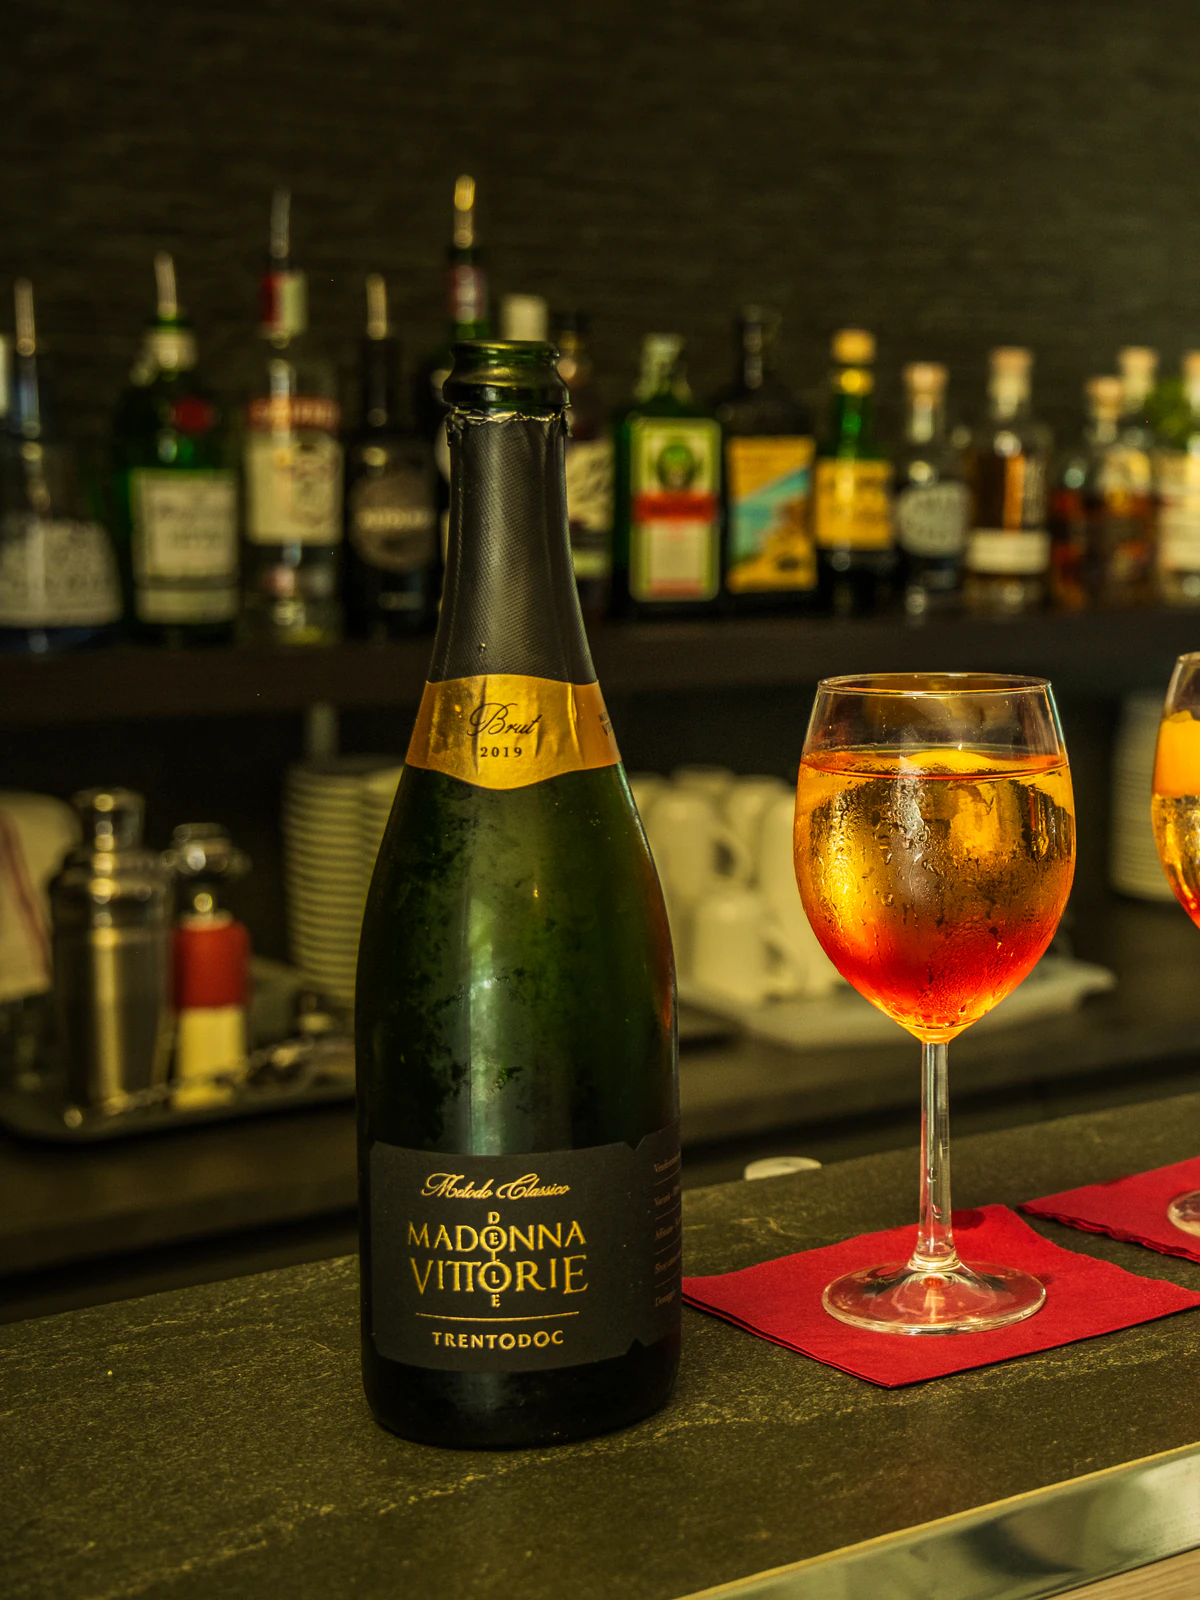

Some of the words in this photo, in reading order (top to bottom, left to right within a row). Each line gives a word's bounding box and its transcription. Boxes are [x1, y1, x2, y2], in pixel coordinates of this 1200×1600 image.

[466, 702, 543, 737] Brut
[480, 746, 523, 758] 2019
[421, 1173, 494, 1200] Metodo
[496, 1173, 571, 1201] Classico
[407, 1220, 588, 1253] MADONNA
[409, 1254, 589, 1294] VITTORIE
[432, 1330, 564, 1350] TRENTODOC
